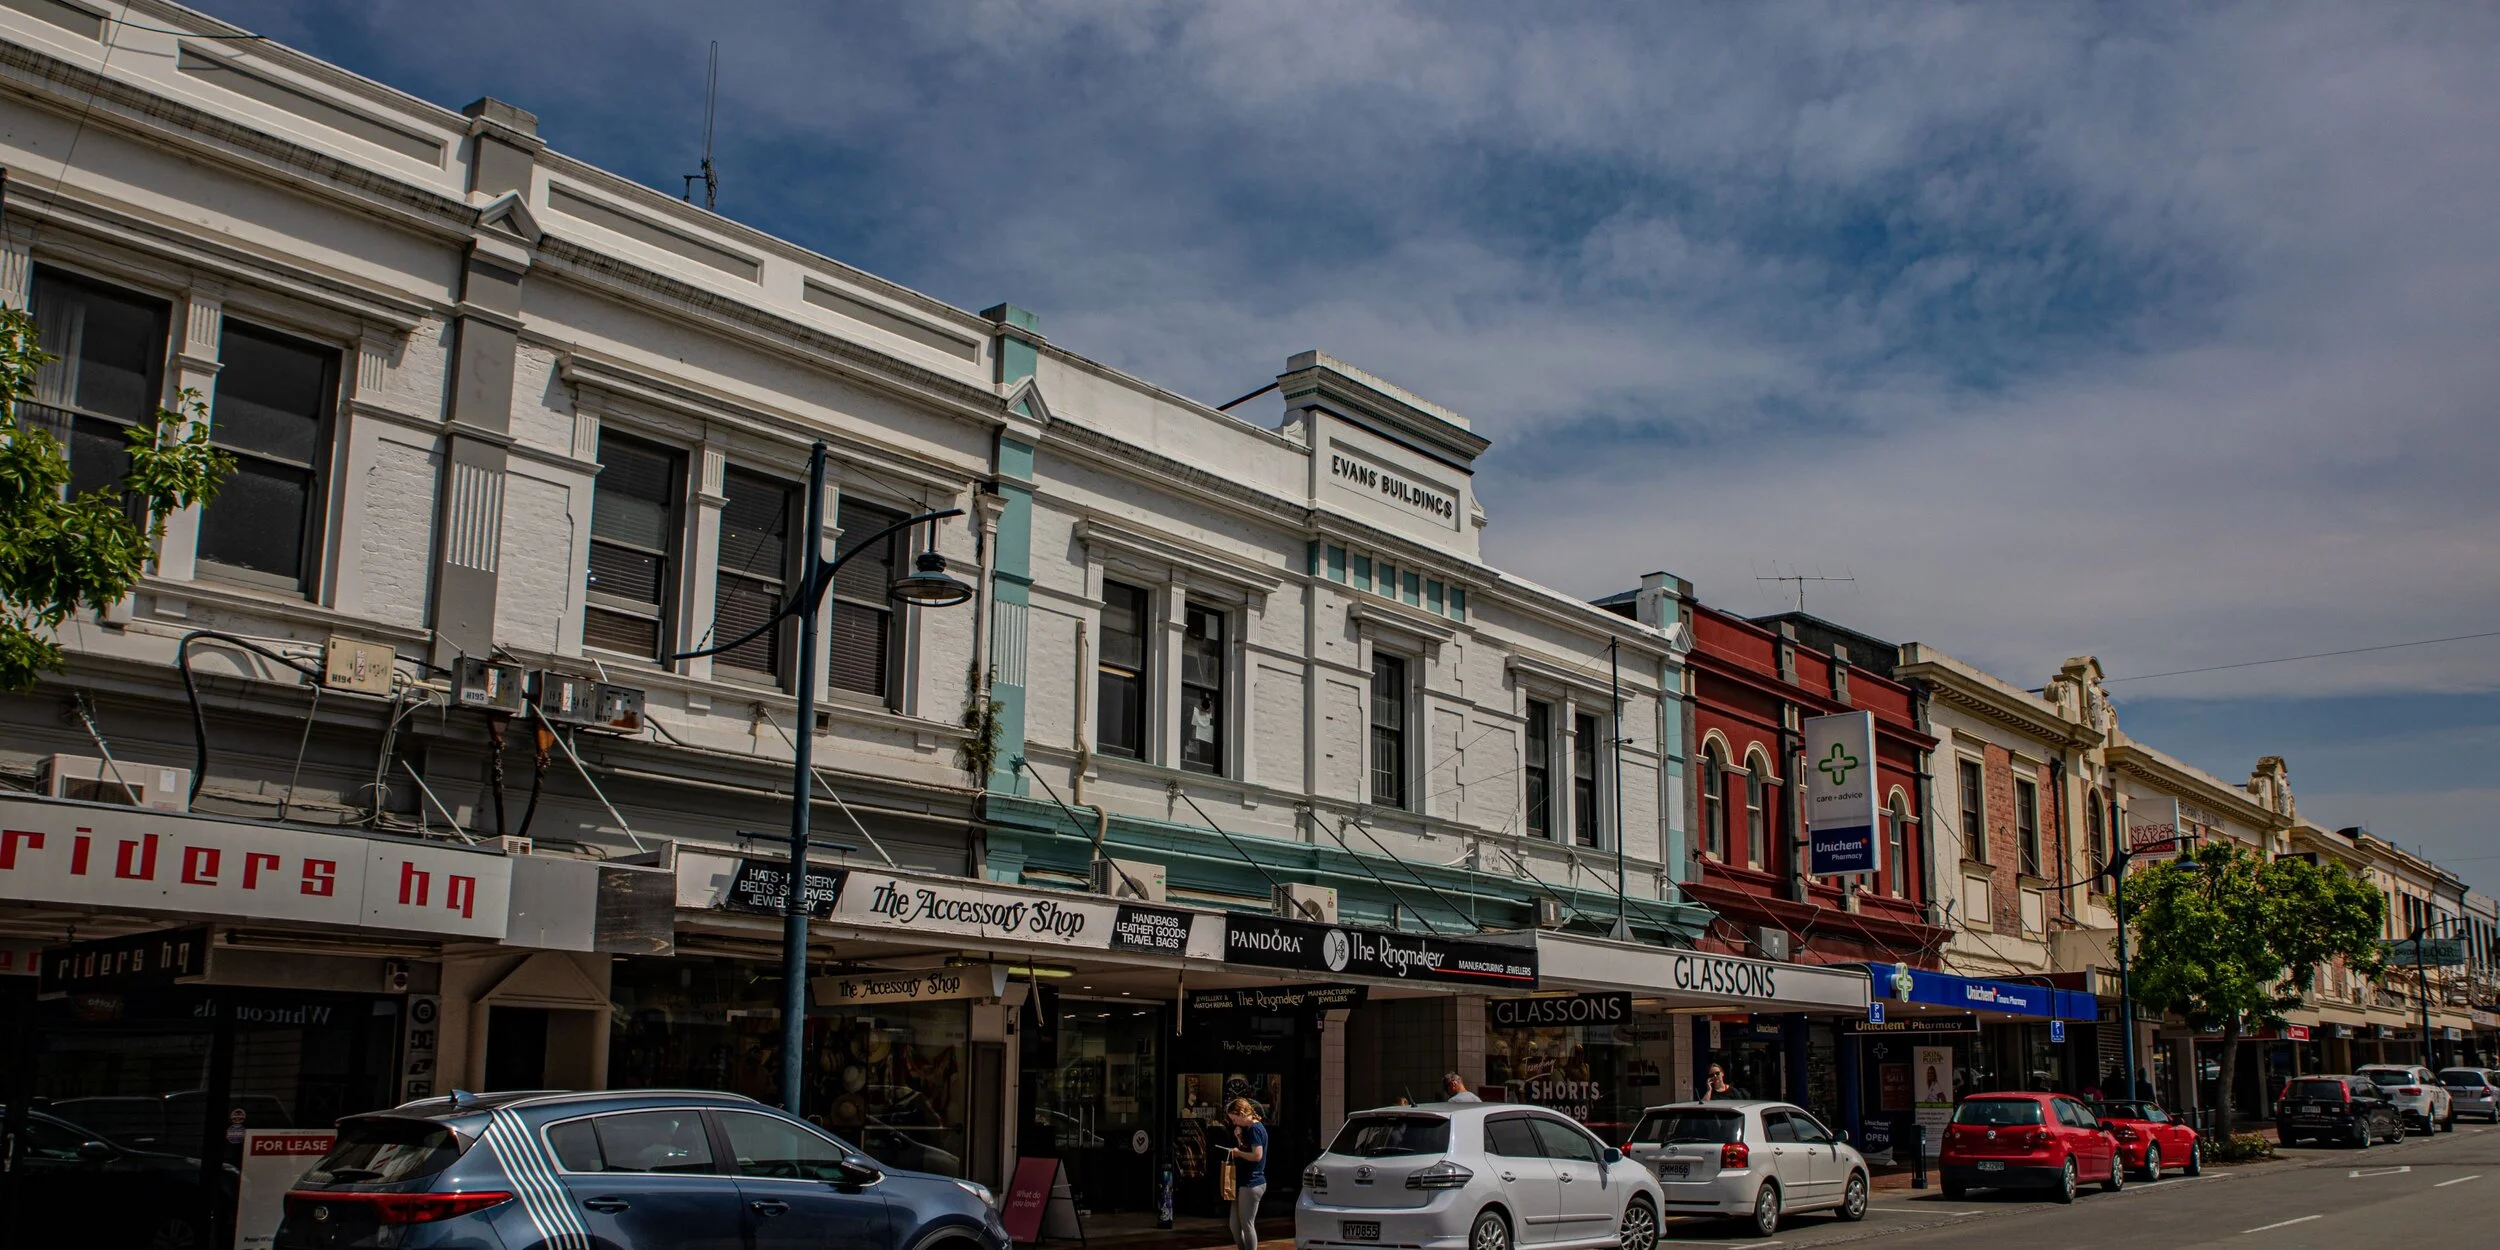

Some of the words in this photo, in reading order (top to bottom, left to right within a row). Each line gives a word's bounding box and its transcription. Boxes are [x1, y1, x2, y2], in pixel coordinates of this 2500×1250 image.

[331, 673, 352, 684] H194
[466, 691, 485, 701] H195
[1816, 794, 1833, 803] care
[1838, 791, 1863, 801] advice
[2131, 824, 2159, 833] NEVER
[2159, 823, 2175, 832] GO
[1816, 839, 1863, 853] Unichem
[0, 826, 336, 898] riders
[1831, 852, 1863, 865] Pharmacy
[749, 868, 779, 884] HATS
[786, 872, 837, 889] SIERY
[739, 880, 774, 896] BELTS
[779, 885, 834, 901] SRVES
[870, 881, 910, 919] The
[900, 889, 1028, 932] Accessory
[1029, 900, 1085, 938] Shop
[1131, 912, 1179, 928] HANDBAGS
[1116, 921, 1154, 936] LEATHER
[1155, 926, 1187, 939] GOODS
[1122, 932, 1154, 946] TRAVEL
[1155, 936, 1179, 949] BAGS
[1350, 932, 1375, 961] The
[1380, 935, 1445, 977] Ringmakers
[57, 946, 145, 981] riders
[1458, 960, 1504, 974] MANUFACTURING
[1505, 966, 1532, 977] JEWELLERS
[1674, 954, 1775, 998] GLASSONS
[838, 979, 858, 999] The
[860, 978, 922, 998] Accessory
[927, 972, 961, 995] Shop
[1307, 988, 1357, 997] MANUFACTURING
[1966, 984, 1995, 1003] Unichem
[1236, 990, 1254, 1007] The
[1256, 988, 1305, 1012] Ringmakers
[1317, 995, 1348, 1005] JEWELLERS
[1496, 996, 1622, 1024] GLASSONS
[1912, 1020, 1962, 1030] Pharmacy
[1221, 1040, 1235, 1051] The
[1236, 1040, 1273, 1055] Ringmakers
[1531, 1079, 1601, 1101] SHORTS
[255, 1140, 283, 1151] FOR
[286, 1140, 329, 1151] LEASE
[1865, 1132, 1889, 1143] OPEN
[1016, 1189, 1032, 1199] What
[1032, 1190, 1041, 1199] do
[1012, 1200, 1024, 1208] you
[1024, 1199, 1040, 1208] love?
[1344, 1226, 1379, 1237] HYD855
